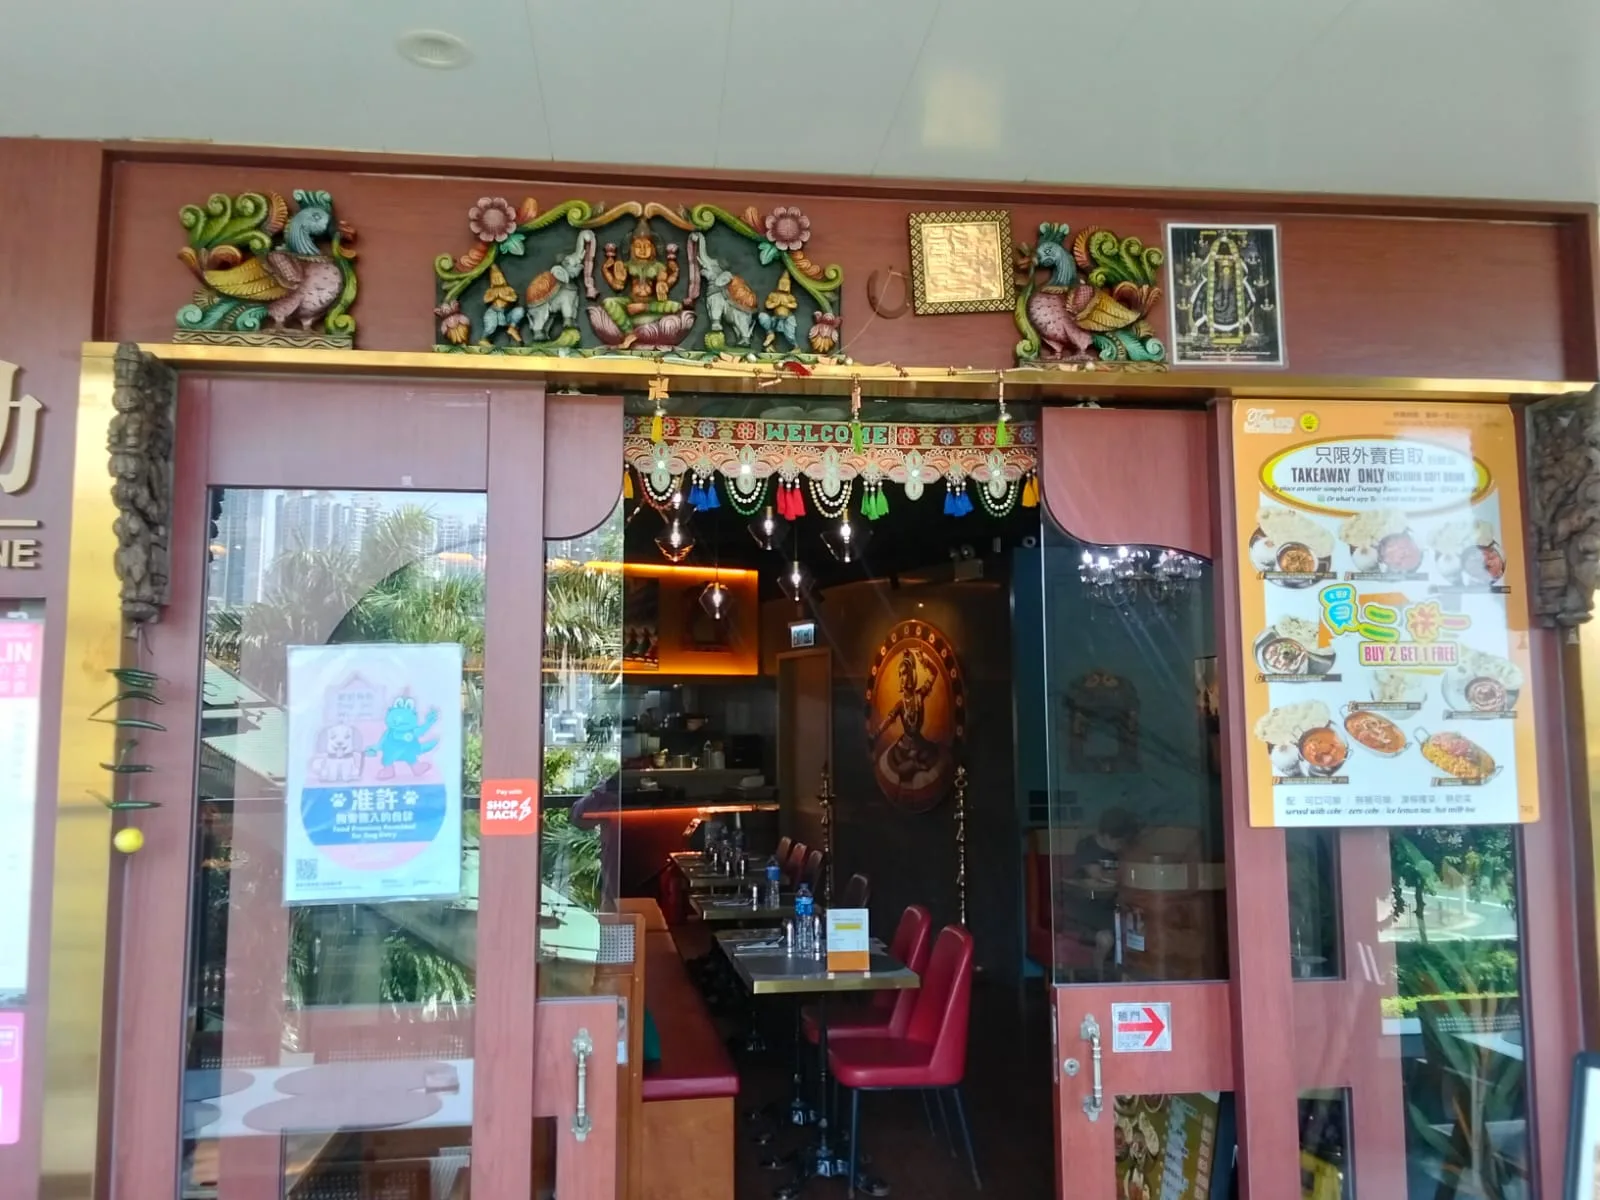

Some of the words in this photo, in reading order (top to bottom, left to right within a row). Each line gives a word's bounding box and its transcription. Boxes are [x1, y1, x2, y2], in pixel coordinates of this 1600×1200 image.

[1315, 446, 1424, 465] 只限外賣自取
[1291, 467, 1350, 483] TAKEAWAY
[1358, 468, 1385, 484] ONLY
[1364, 645, 1385, 661] BUY
[1389, 646, 1397, 661] 2
[1400, 646, 1418, 662] GET
[1432, 646, 1455, 662] FREE
[351, 788, 399, 811] 准許
[486, 800, 519, 810] SHOP
[486, 810, 519, 820] BACK
